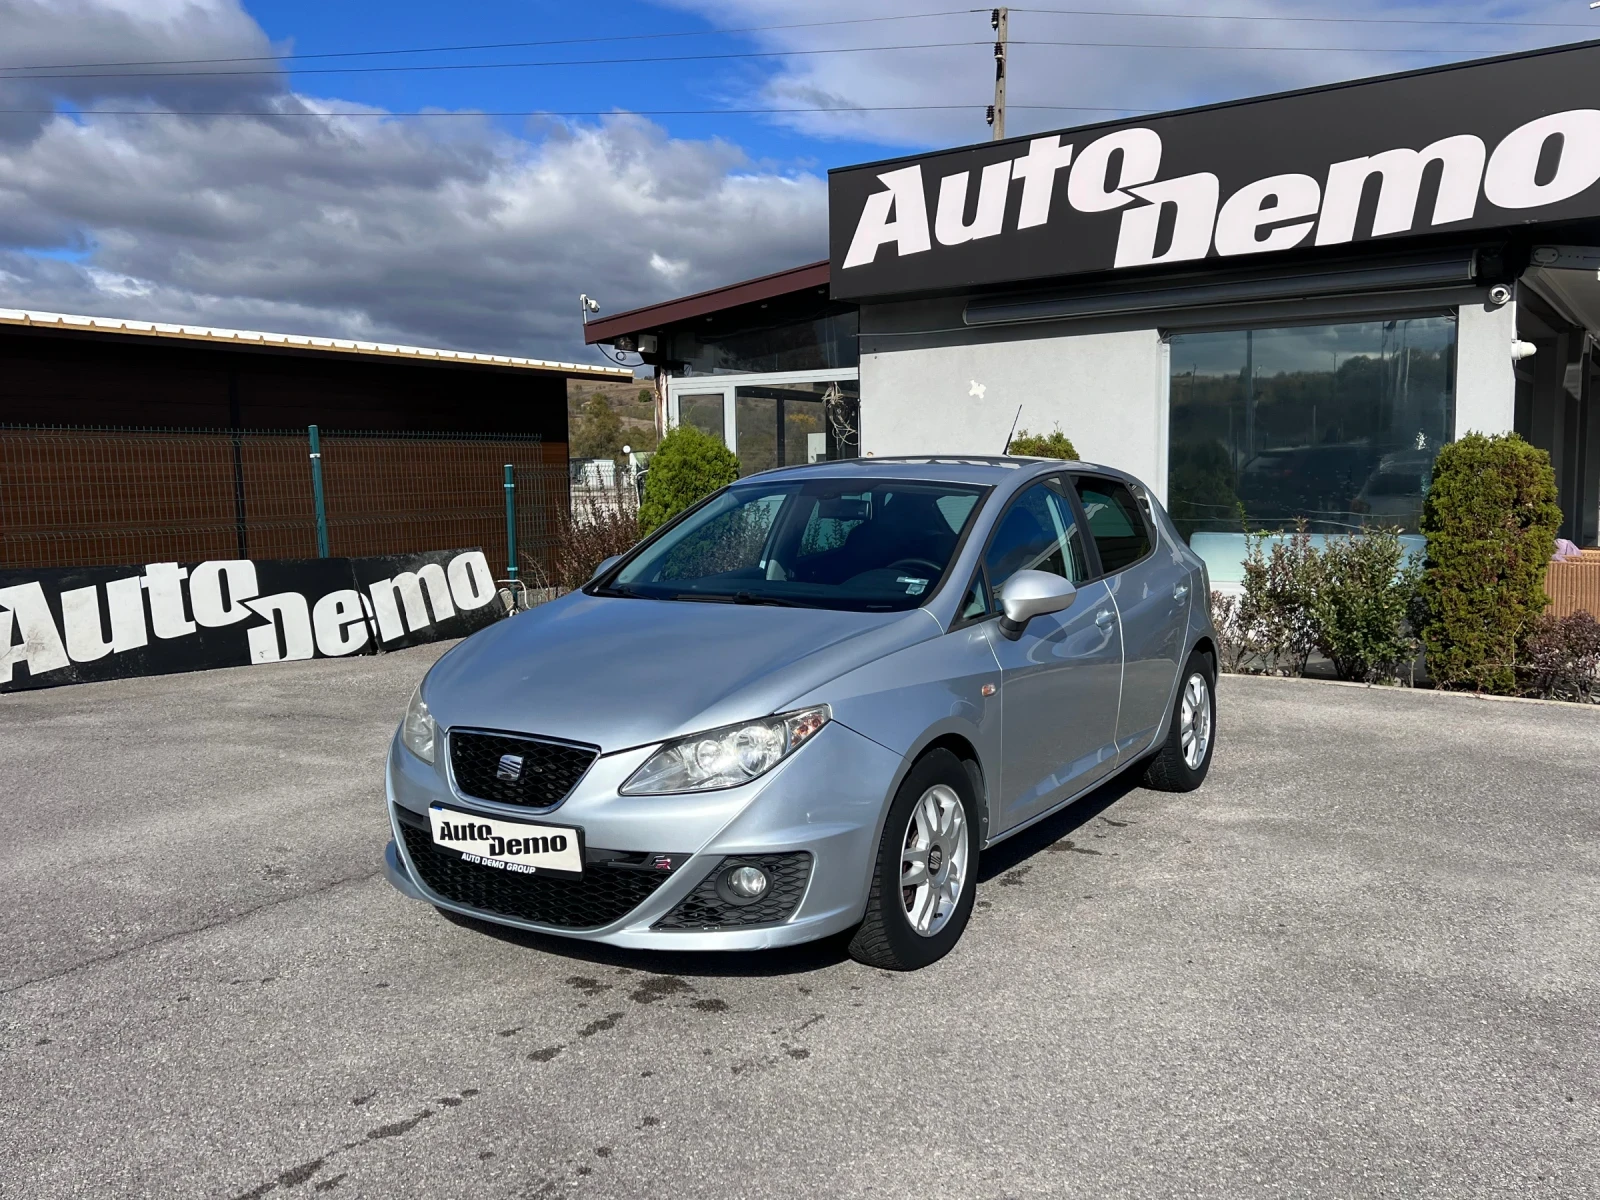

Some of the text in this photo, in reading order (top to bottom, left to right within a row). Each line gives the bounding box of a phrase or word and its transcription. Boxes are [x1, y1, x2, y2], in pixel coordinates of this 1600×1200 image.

[842, 109, 1600, 269] Auto Demo
[0, 551, 498, 684] Auto Demo
[440, 821, 567, 856] Auto Demo
[461, 852, 536, 875] AUTO DEMO GROUP
[649, 855, 671, 870] FR
